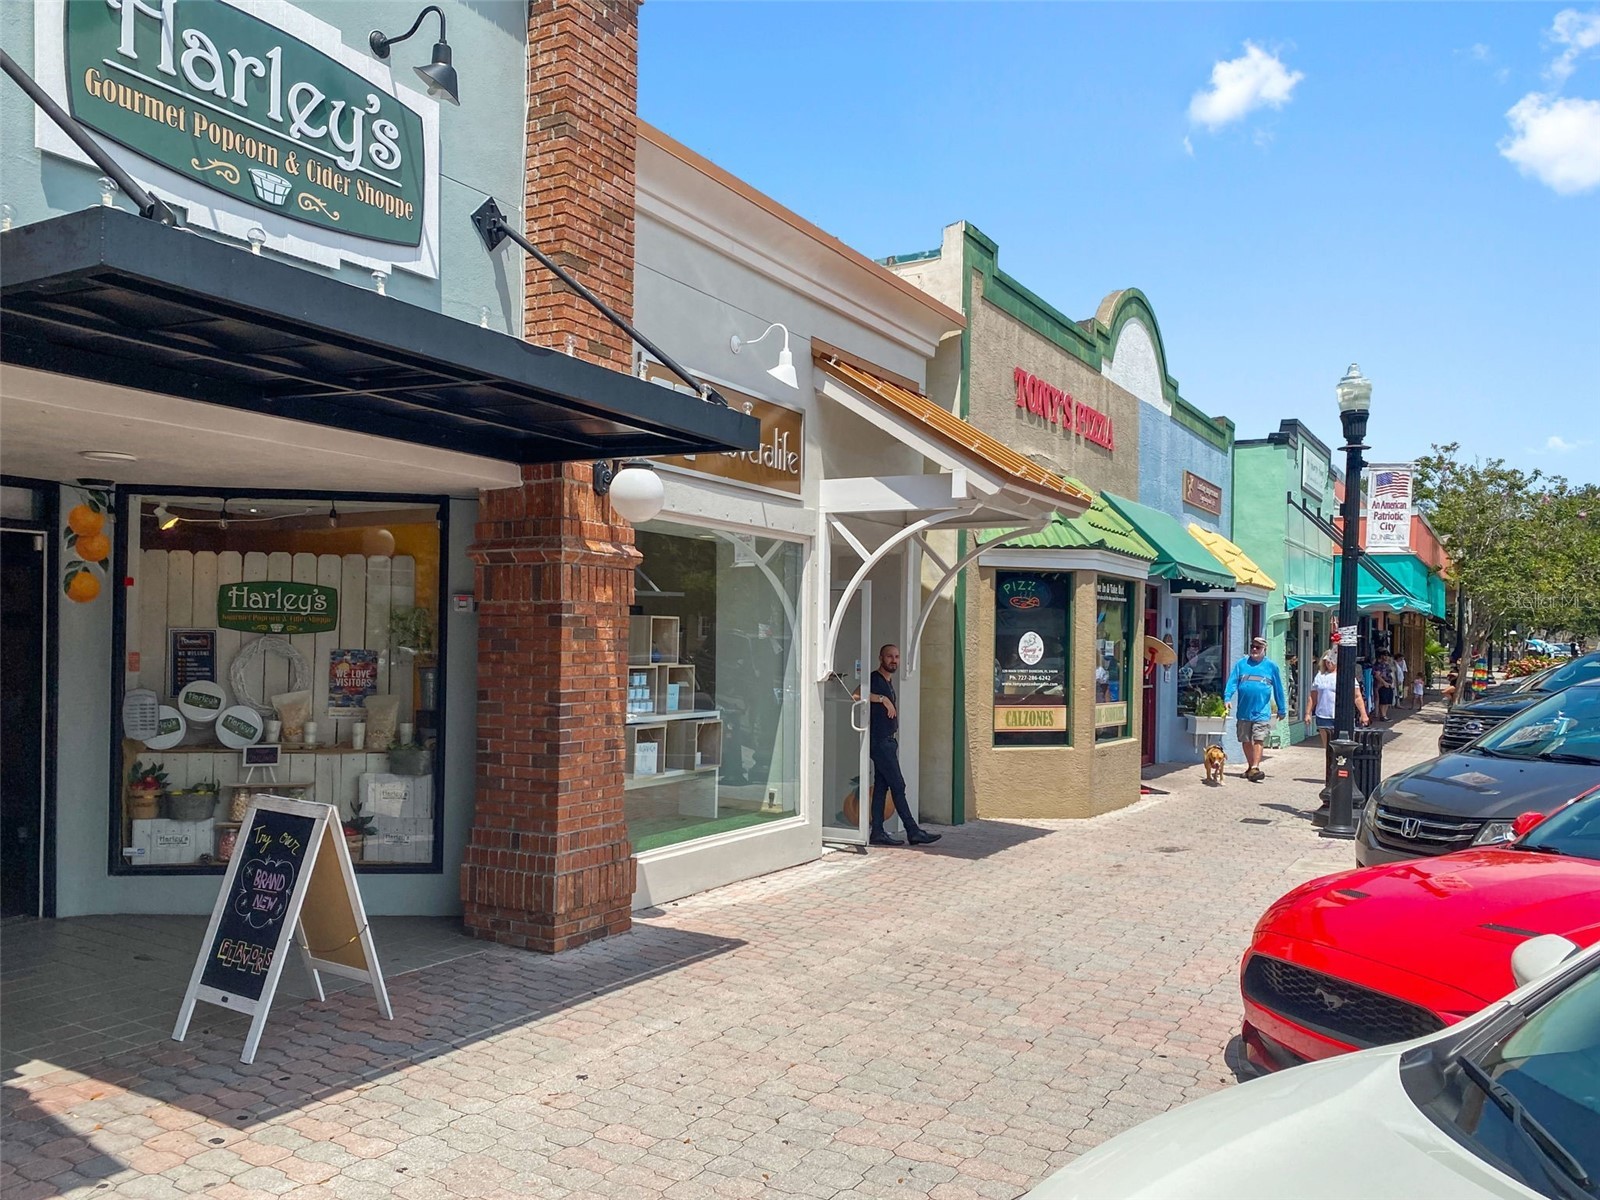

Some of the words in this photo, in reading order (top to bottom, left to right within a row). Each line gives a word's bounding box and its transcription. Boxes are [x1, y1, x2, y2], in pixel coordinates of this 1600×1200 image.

[104, 0, 402, 171] Harley's
[84, 67, 186, 132] Gourmet
[193, 111, 279, 169] Popcorn
[285, 151, 301, 176] &
[306, 159, 352, 197] Cider
[356, 178, 415, 221] Shoppe
[1014, 366, 1073, 430] TONY'S
[1075, 401, 1116, 451] PIZZA
[1372, 500, 1380, 509] An
[1381, 500, 1407, 509] American
[1373, 511, 1404, 520] Patriotic
[1380, 522, 1396, 532] City
[228, 586, 327, 616] Harley's
[336, 669, 348, 678] WE
[351, 669, 371, 679] LOVE
[336, 679, 372, 687] VISITORS
[1005, 710, 1055, 727] CALZONES
[253, 825, 273, 854] Try
[279, 831, 300, 856] our
[253, 868, 286, 892] BRAND
[252, 893, 277, 910] NEW
